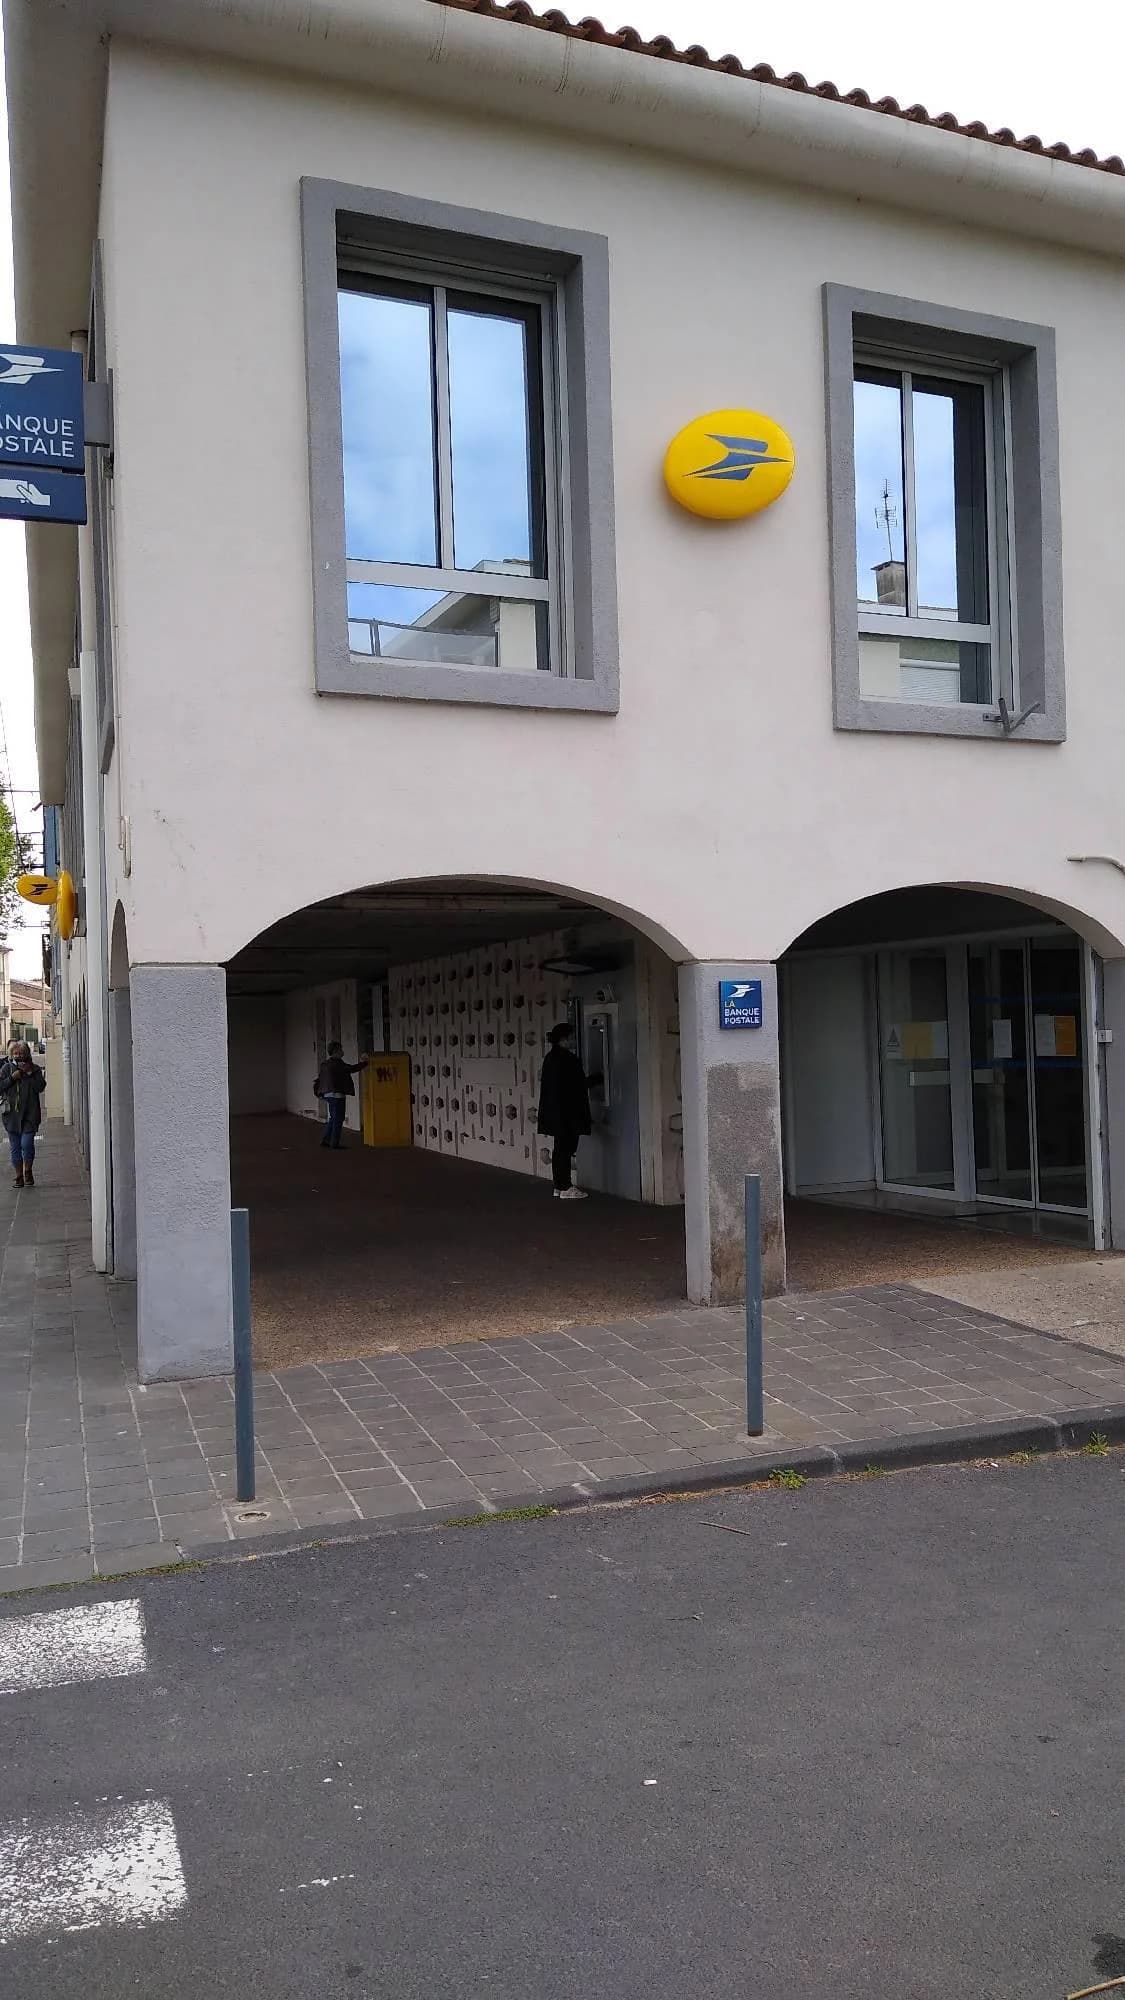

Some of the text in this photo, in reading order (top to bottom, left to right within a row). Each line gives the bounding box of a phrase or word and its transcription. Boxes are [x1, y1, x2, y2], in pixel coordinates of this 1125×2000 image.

[0, 413, 74, 436] NQUE
[0, 435, 75, 458] STALE
[724, 1000, 736, 1008] LA
[724, 1007, 760, 1017] BANQUE
[724, 1016, 760, 1025] POSTALE
